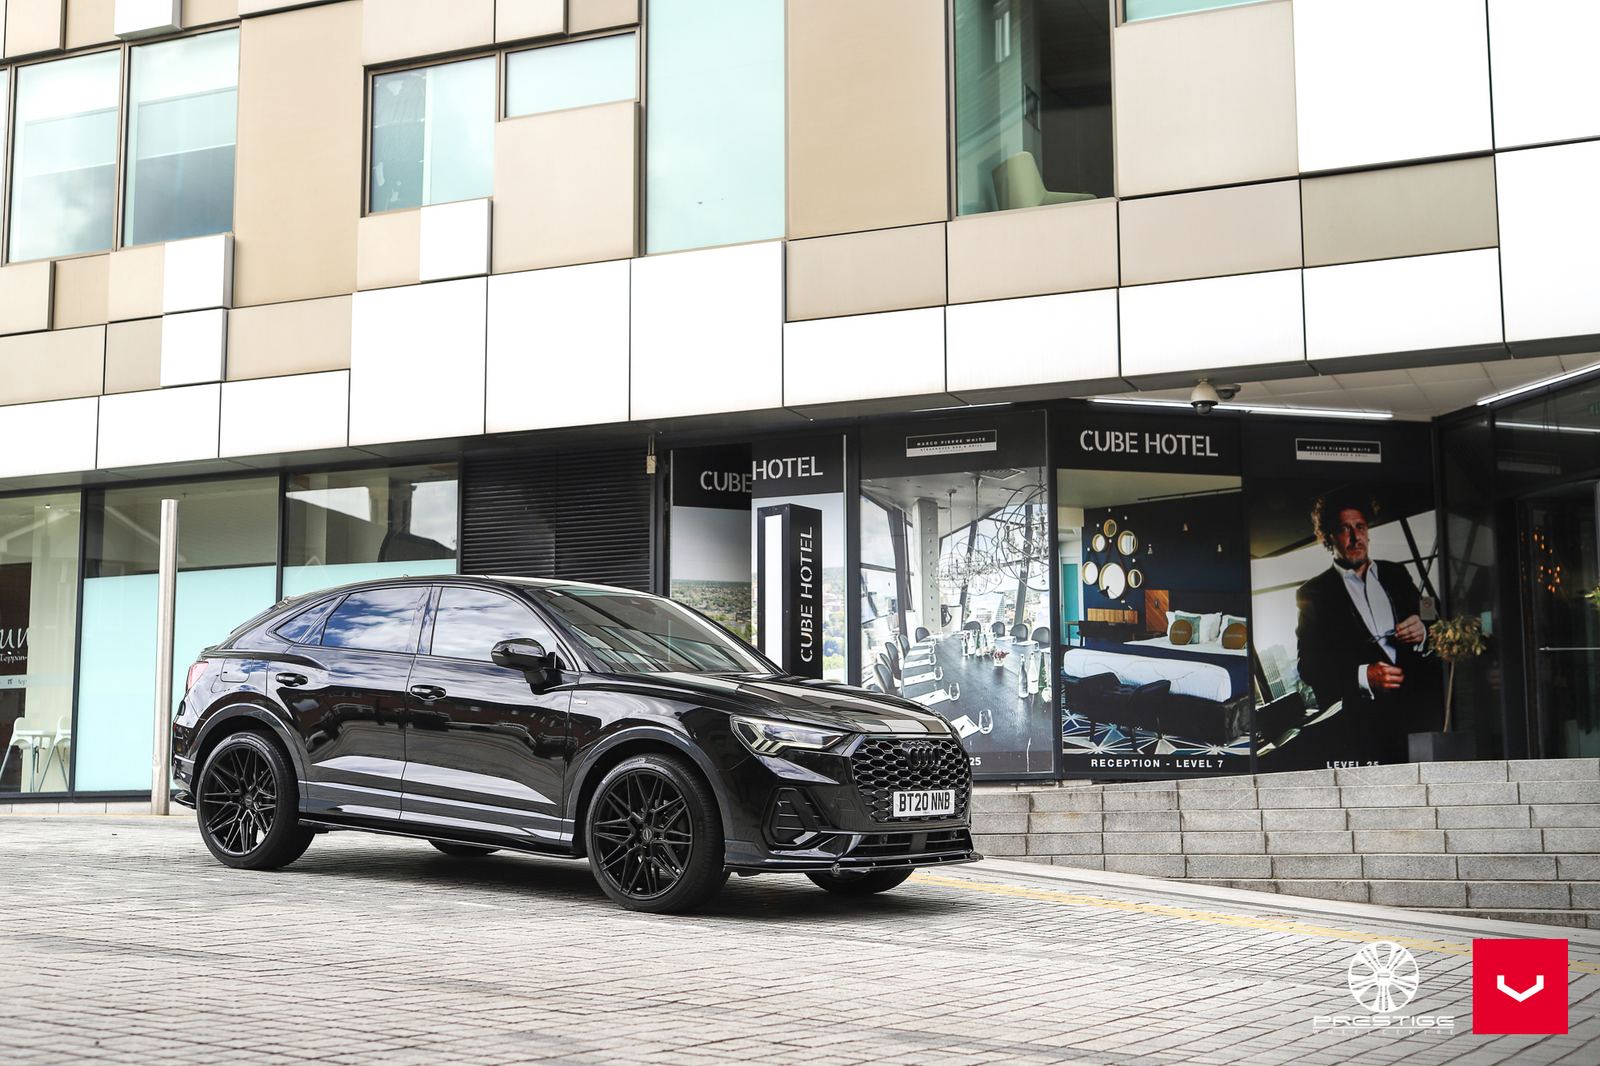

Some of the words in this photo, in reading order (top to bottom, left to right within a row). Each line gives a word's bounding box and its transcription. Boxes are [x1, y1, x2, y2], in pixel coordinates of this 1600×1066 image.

[1080, 430, 1138, 453] CUBE
[1145, 433, 1219, 457] HOTEL
[700, 470, 752, 493] CUBE
[752, 456, 824, 481] HOTEL
[800, 526, 813, 599] HOTEL
[800, 605, 813, 663] CUBE
[969, 757, 982, 766] 25
[1091, 759, 1160, 768] RECEPTION
[1176, 759, 1213, 768] LEVEL
[1217, 759, 1224, 768] 7
[1326, 761, 1360, 769] LEVEL
[899, 793, 929, 812] BT20
[931, 791, 951, 811] NNB
